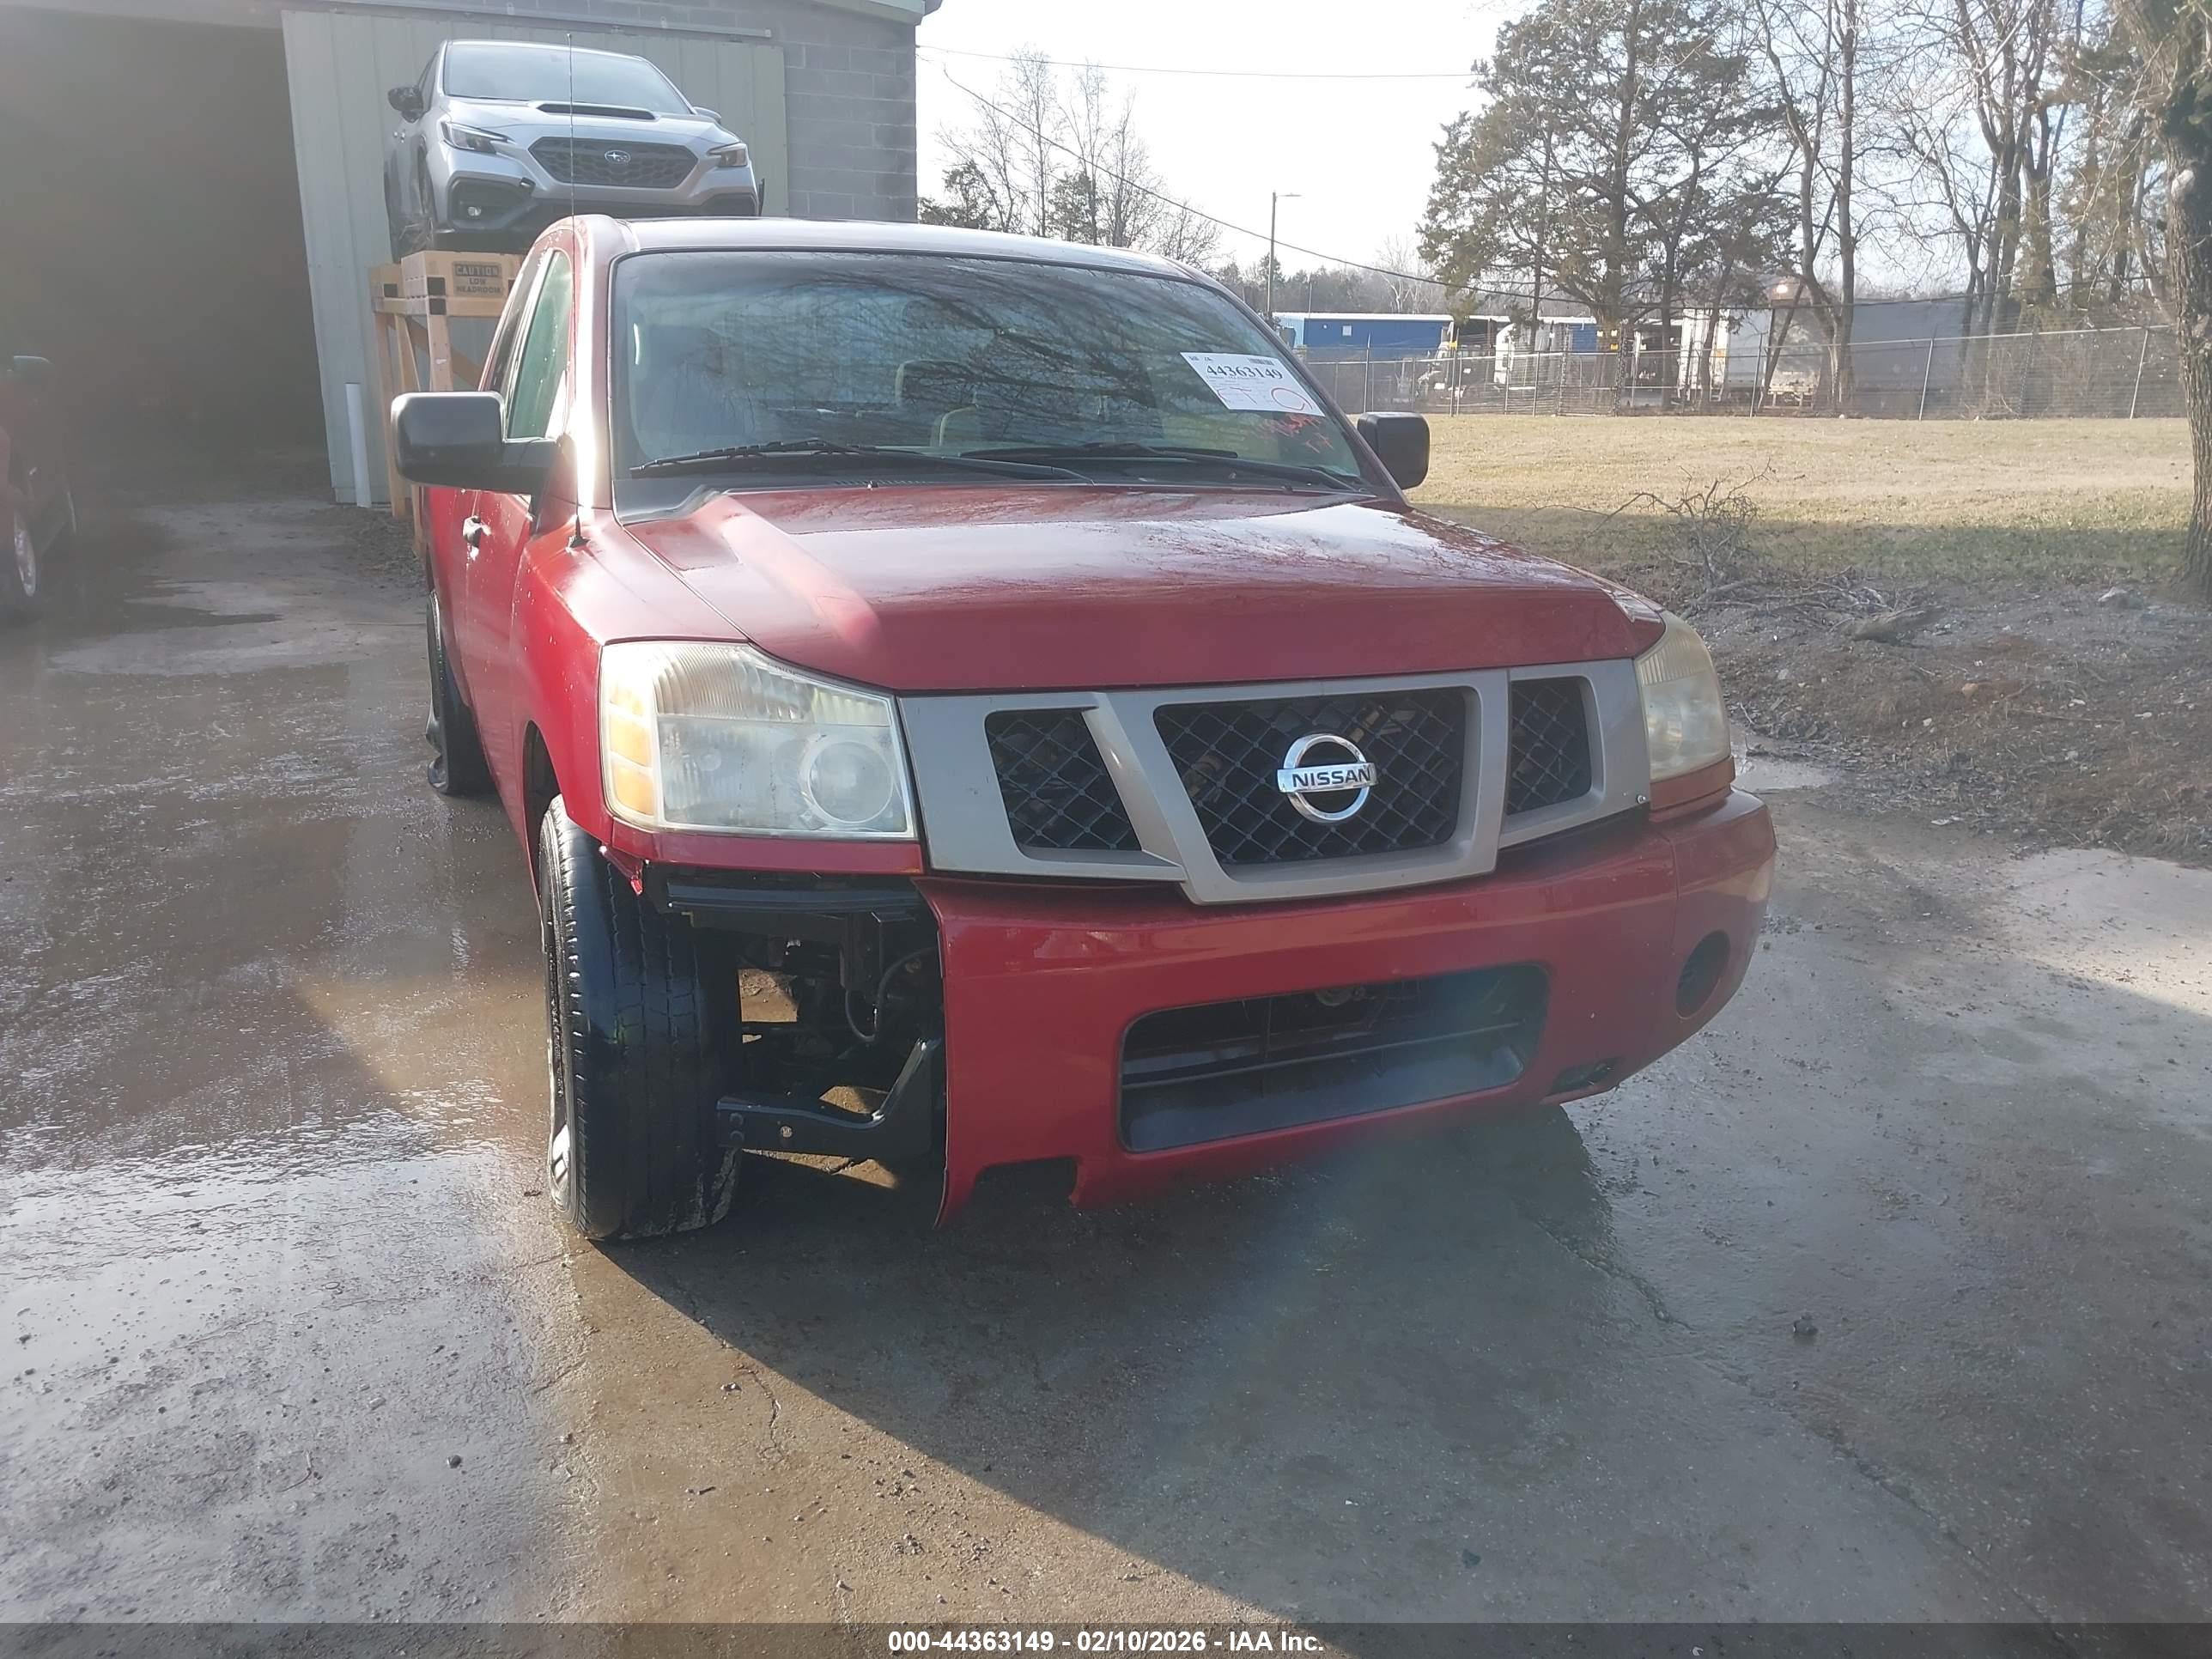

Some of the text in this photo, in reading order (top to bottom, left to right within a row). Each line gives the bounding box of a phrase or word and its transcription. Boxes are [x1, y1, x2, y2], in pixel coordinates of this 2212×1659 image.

[456, 264, 498, 276] CAUTION
[1206, 365, 1283, 379] 44363149
[1292, 769, 1371, 787] NISSAN
